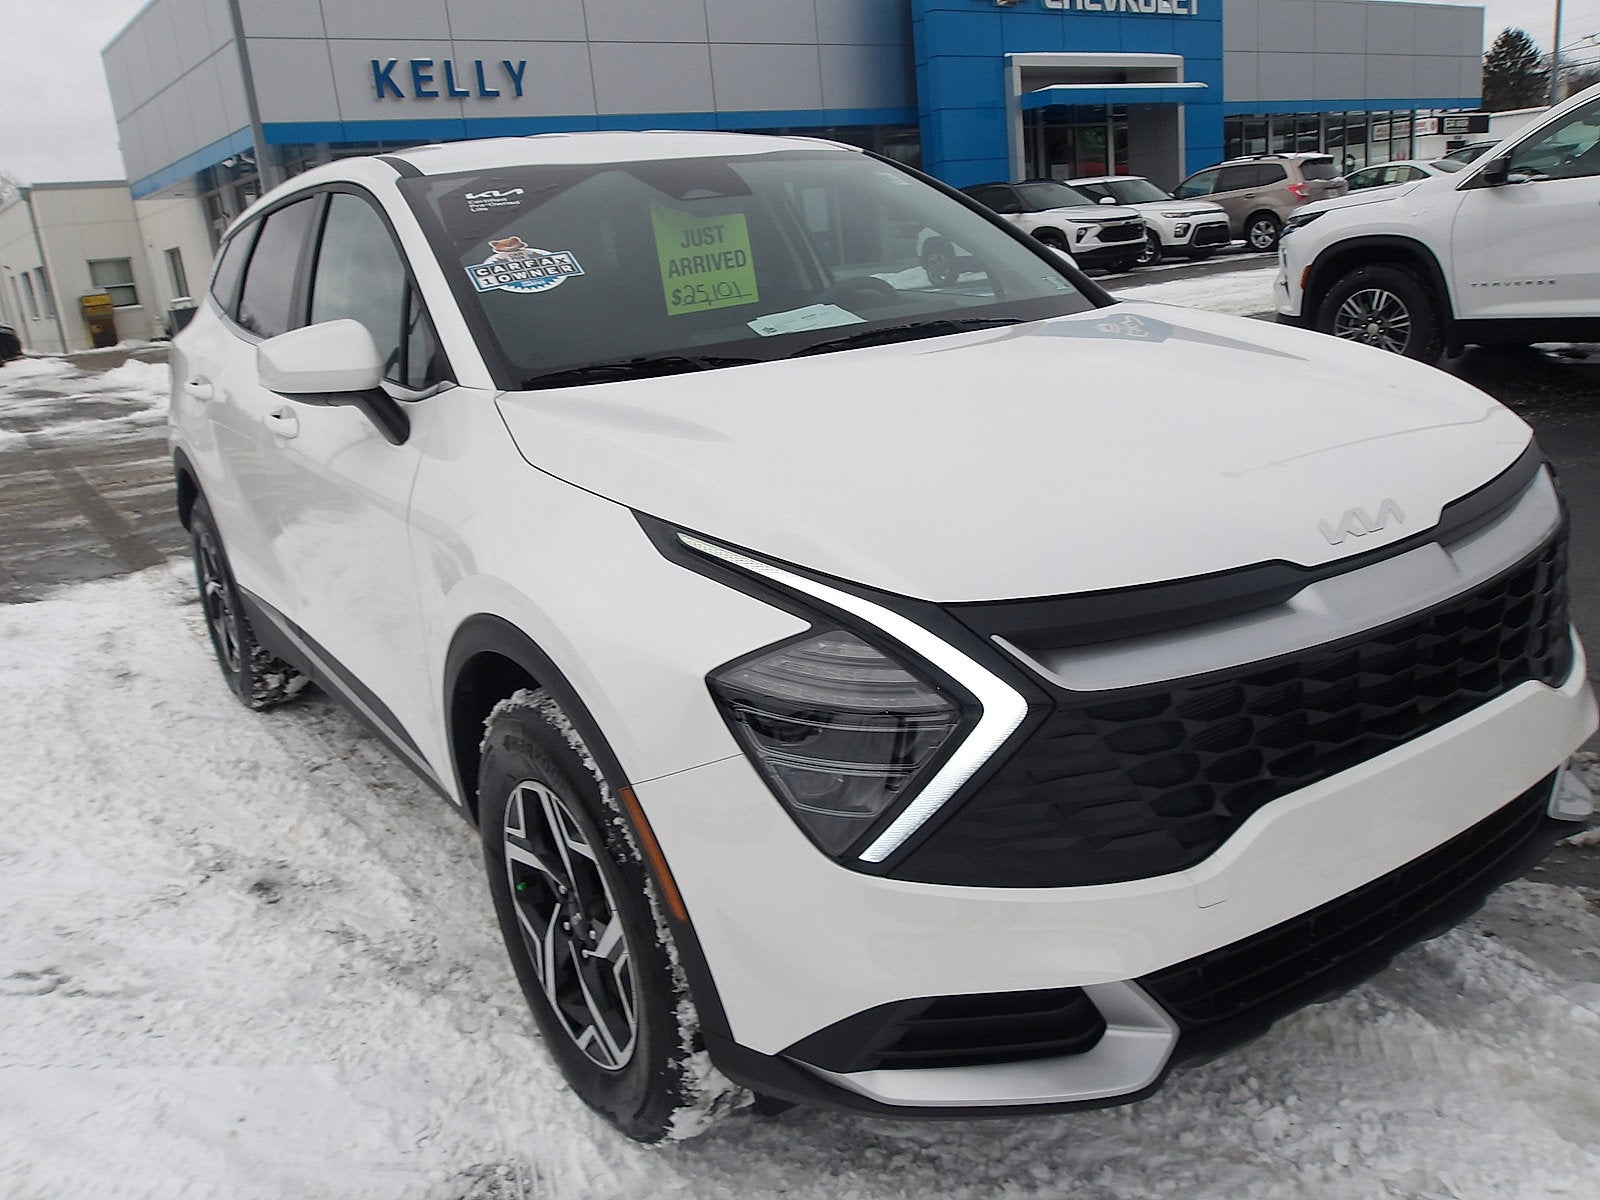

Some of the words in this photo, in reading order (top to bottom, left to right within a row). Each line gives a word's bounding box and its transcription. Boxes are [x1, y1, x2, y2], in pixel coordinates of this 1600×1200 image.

[371, 57, 527, 98] KELLY
[681, 225, 724, 248] JUST
[475, 257, 569, 276] CARFAX
[482, 278, 494, 286] 1
[497, 264, 575, 283] OWNER
[668, 249, 747, 278] ARRIVED
